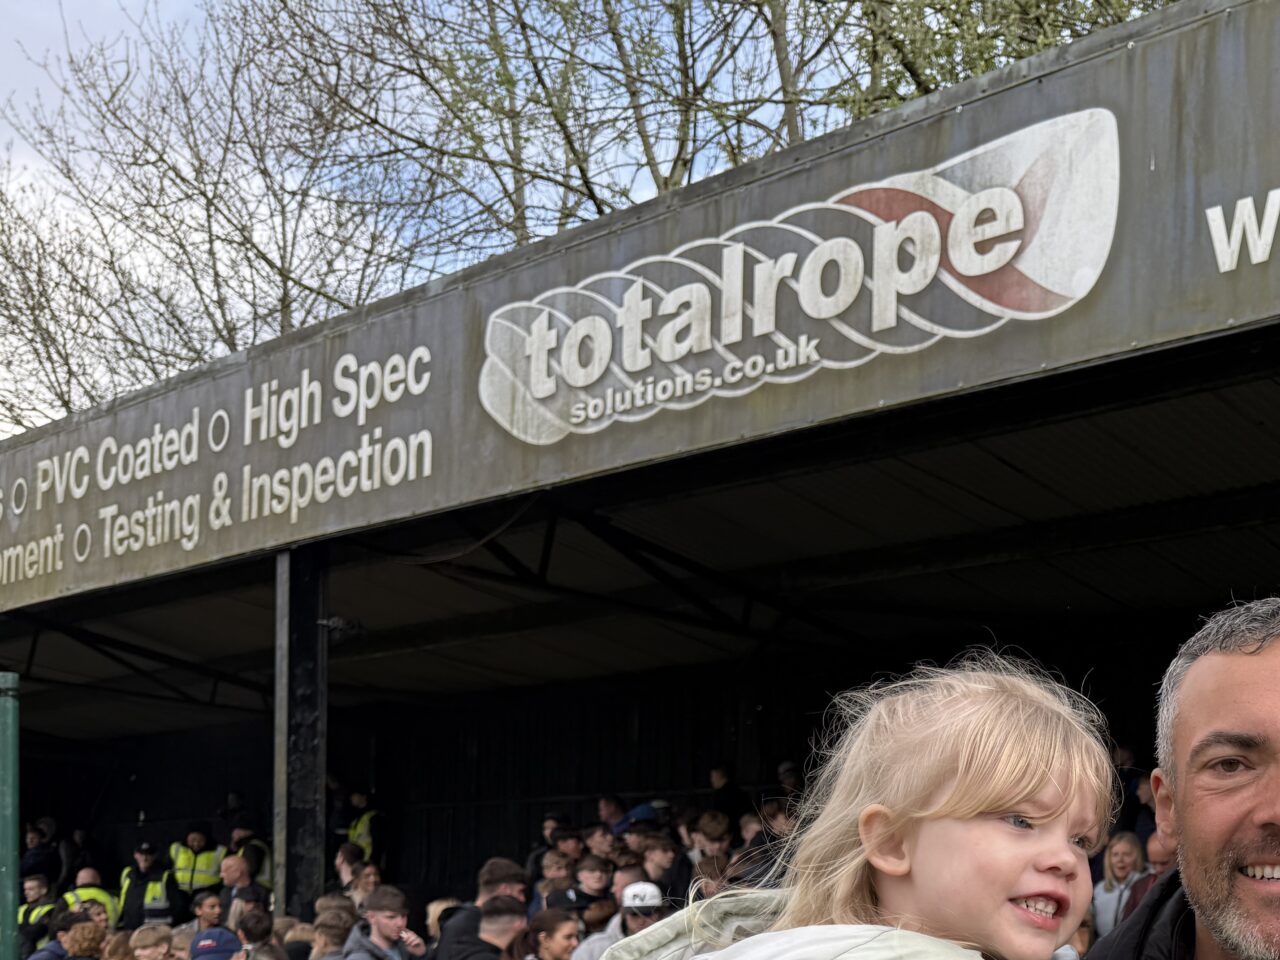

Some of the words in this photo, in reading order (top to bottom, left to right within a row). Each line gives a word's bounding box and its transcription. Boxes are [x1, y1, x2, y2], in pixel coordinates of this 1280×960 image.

[524, 186, 1026, 399] totalrope
[36, 446, 90, 511] PVC
[96, 407, 200, 492] Coated
[244, 368, 322, 449] High
[332, 345, 432, 426] Spec
[568, 333, 821, 426] solutions.co.uk
[0, 523, 64, 585] ment
[98, 491, 200, 558] Testing
[208, 472, 232, 531] &
[241, 427, 433, 524] Inspection
